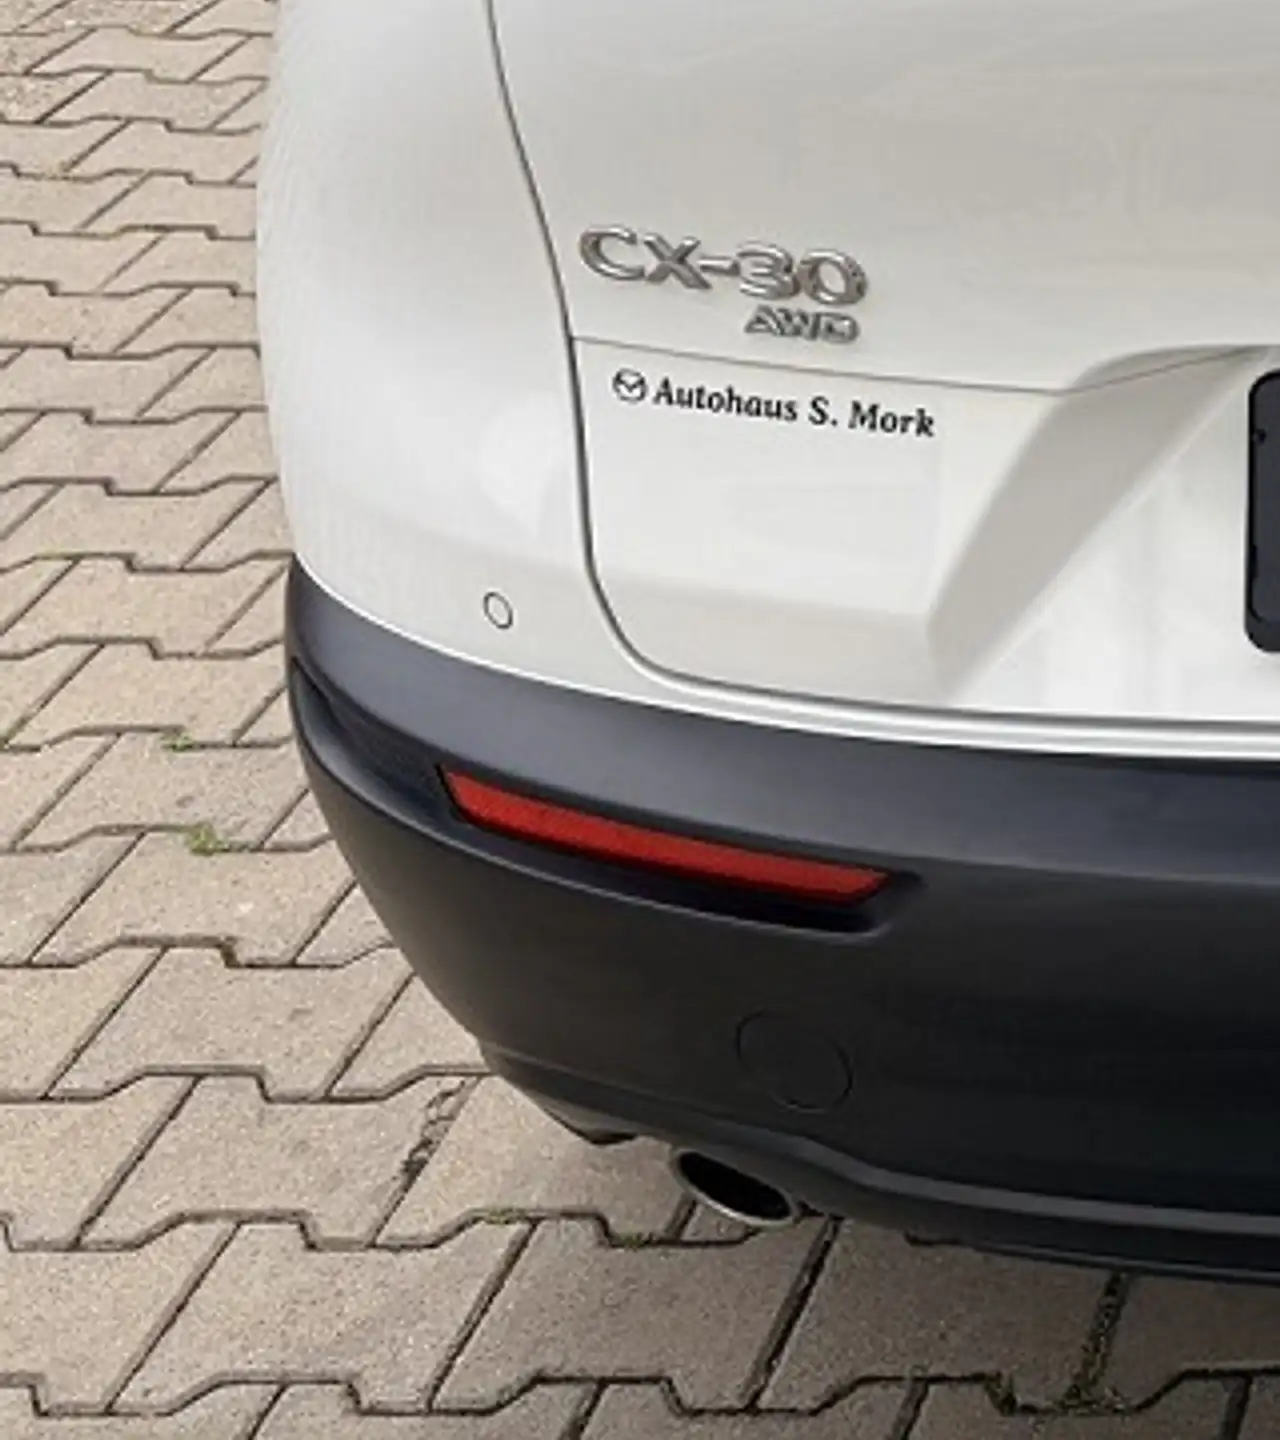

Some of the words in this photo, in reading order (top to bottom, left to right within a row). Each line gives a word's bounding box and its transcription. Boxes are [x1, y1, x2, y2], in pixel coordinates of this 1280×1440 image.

[579, 224, 869, 307] CX-30
[743, 304, 860, 345] AWD
[652, 376, 798, 423] Autohaus
[808, 396, 838, 427] S.
[847, 400, 935, 438] Mork
